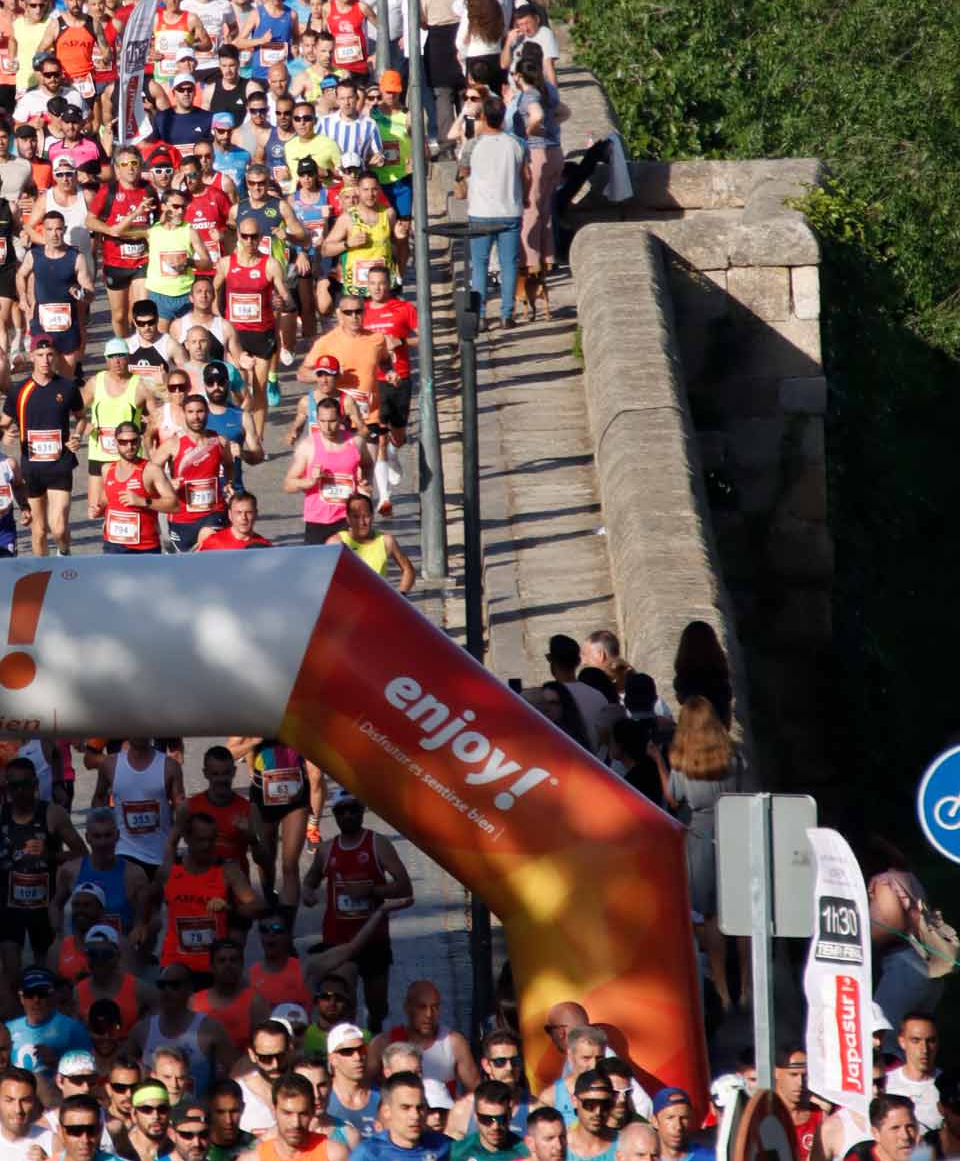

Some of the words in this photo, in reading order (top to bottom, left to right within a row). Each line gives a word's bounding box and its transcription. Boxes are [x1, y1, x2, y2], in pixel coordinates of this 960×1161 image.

[384, 676, 551, 811] enjoy!
[421, 774, 469, 813] sentirse
[466, 807, 496, 834] bien
[822, 904, 857, 936] 1h30
[841, 994, 862, 1090] Japasur
